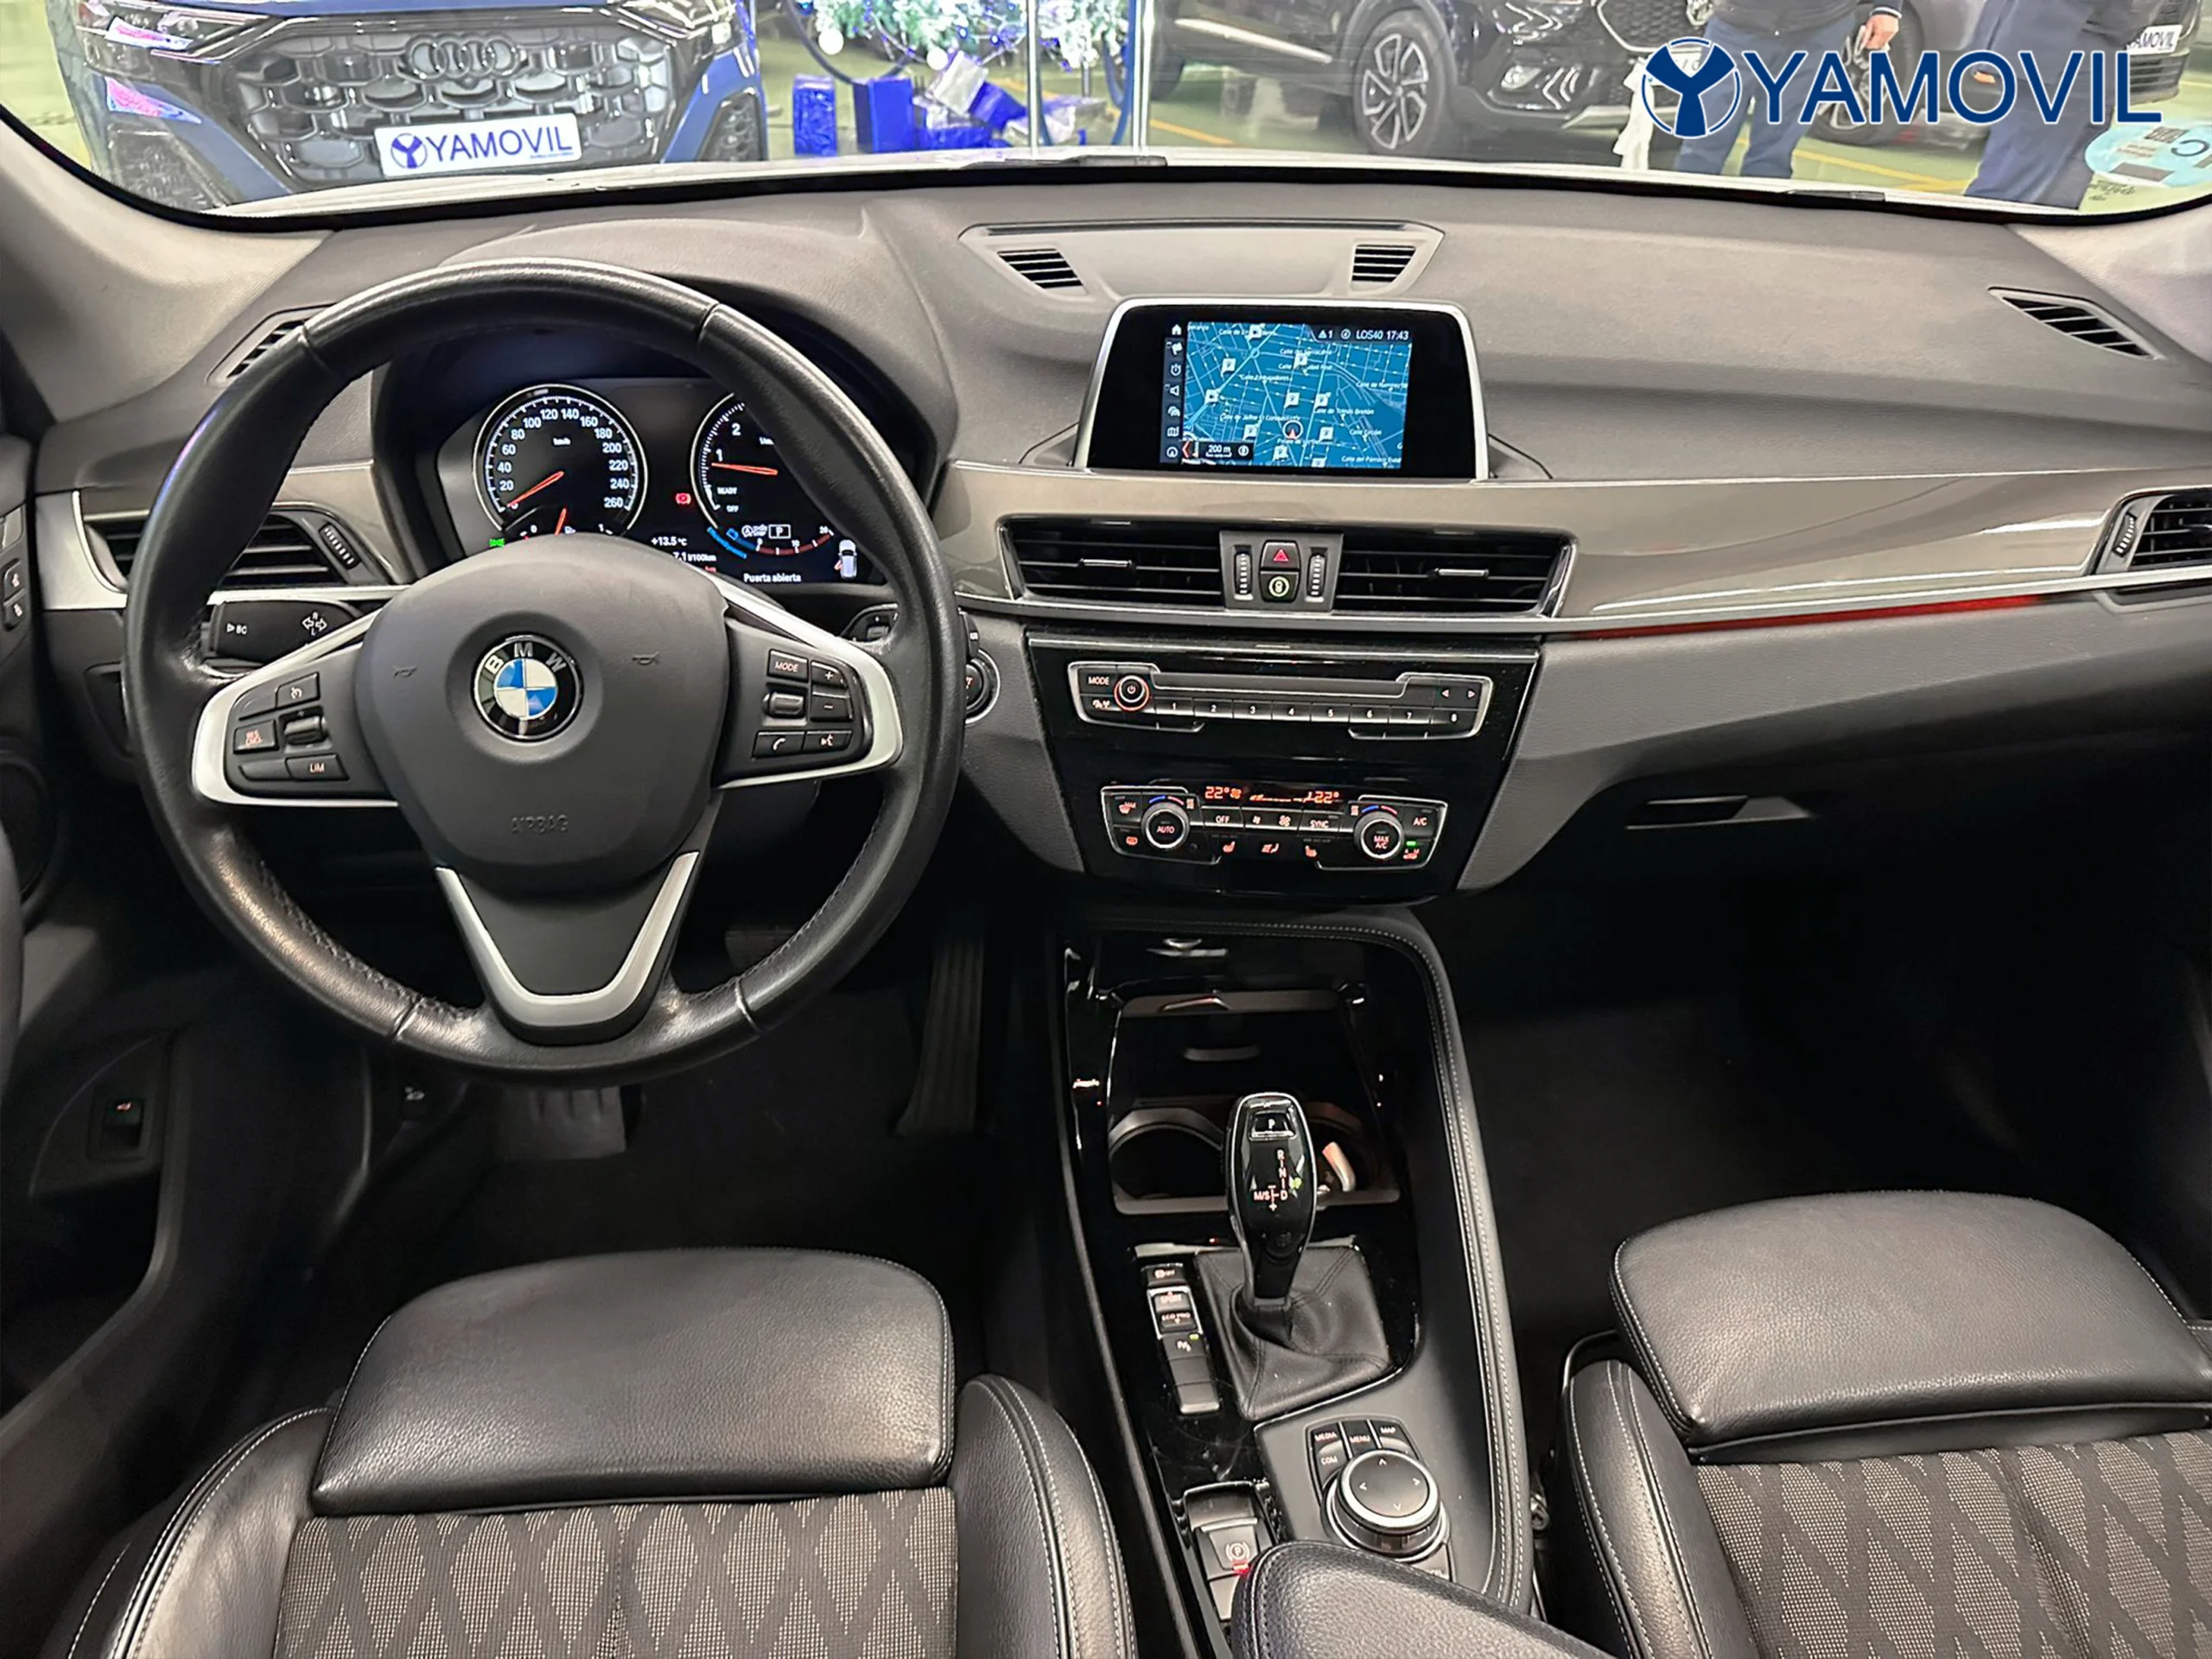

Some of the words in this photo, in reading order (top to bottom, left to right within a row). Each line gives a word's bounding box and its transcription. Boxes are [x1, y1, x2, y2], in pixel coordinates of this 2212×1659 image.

[426, 126, 573, 162] YAMOVIL
[1356, 330, 1382, 340] LOS40
[1387, 330, 1409, 340] 17:43
[540, 409, 558, 420] 120
[561, 408, 580, 419] 140
[523, 417, 542, 428] 100
[580, 416, 598, 427] 160
[511, 429, 525, 440] 80
[594, 428, 613, 439] 180
[731, 423, 741, 436] 2
[502, 444, 516, 455] 60
[602, 442, 622, 454] 200
[1208, 444, 1223, 453] 200
[715, 448, 723, 462] 1
[498, 461, 512, 473] 40
[608, 460, 628, 471] 220
[499, 480, 514, 492] 20
[610, 479, 630, 489] 240
[604, 497, 624, 508] 260
[776, 527, 784, 537] P
[651, 536, 677, 547] +13.5
[743, 573, 771, 583] Puerta
[772, 573, 802, 583] abierta
[236, 624, 247, 635] BC
[484, 642, 566, 675] BMW
[775, 661, 799, 673] MODE
[1088, 676, 1110, 685] MODE
[1211, 704, 1217, 713] 2
[1249, 705, 1255, 715] 3
[1288, 708, 1295, 716] 4
[1328, 709, 1334, 717] 5
[1366, 710, 1373, 719] 6
[309, 763, 325, 773] LIM
[1215, 815, 1230, 823] OFF
[1413, 817, 1427, 826] A/C
[1156, 825, 1175, 835] AUTO
[1309, 820, 1330, 830] SYNC
[1373, 835, 1390, 843] MAX
[1375, 842, 1388, 850] A/C
[1268, 1118, 1275, 1129] P
[1277, 1149, 1285, 1160] R
[1279, 1167, 1287, 1178] N
[1253, 1191, 1270, 1201] M/S
[1281, 1190, 1288, 1200] D
[1314, 1431, 1338, 1442] MEDIA
[1349, 1435, 1370, 1444] MENU
[1320, 1455, 1338, 1465] COM
